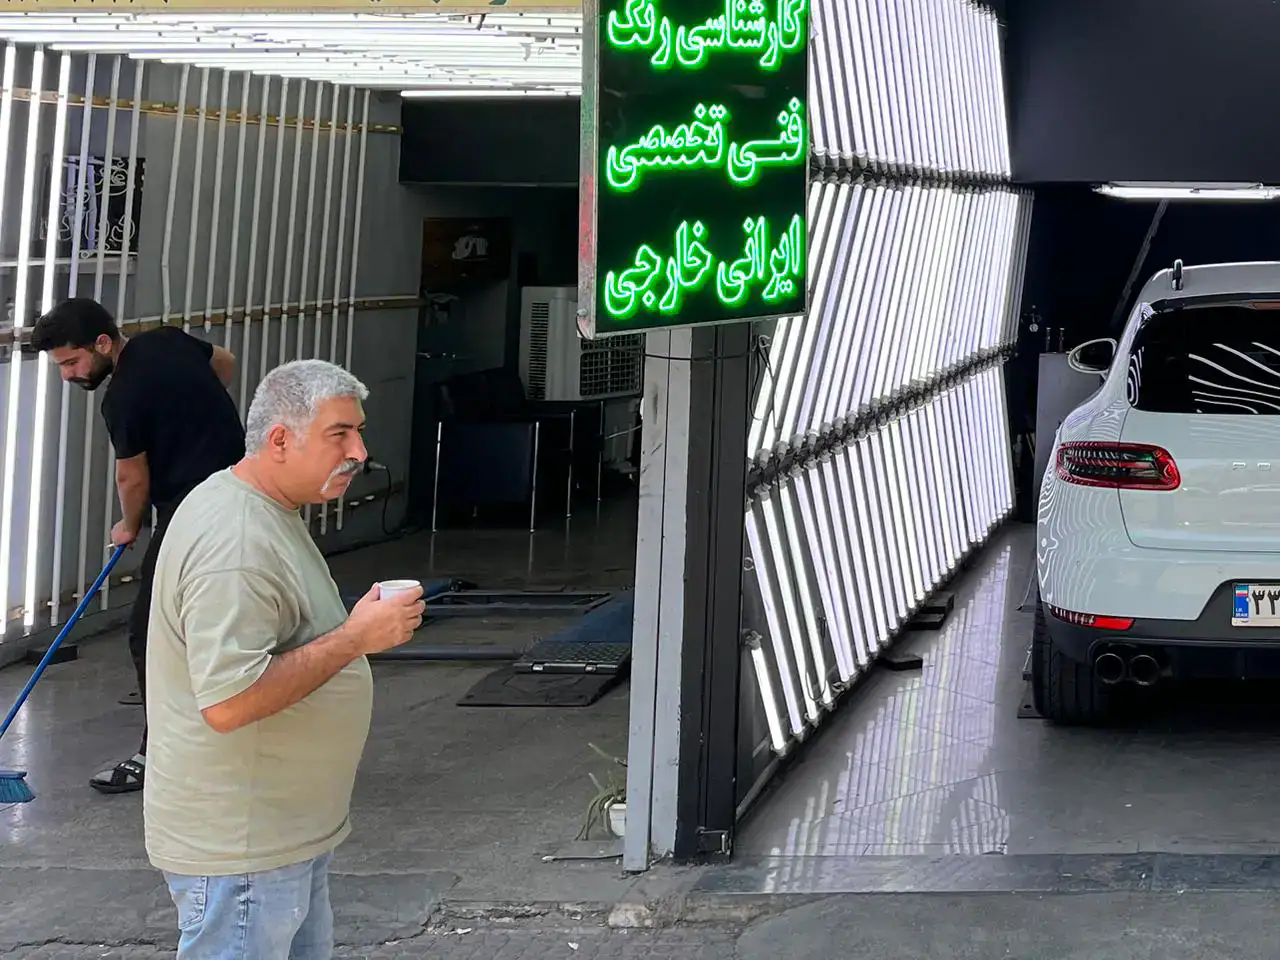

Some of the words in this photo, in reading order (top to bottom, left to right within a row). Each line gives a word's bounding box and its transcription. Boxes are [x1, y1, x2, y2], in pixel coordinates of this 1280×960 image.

[606, 103, 726, 188] تخصصی
[727, 97, 804, 182] فنی
[605, 220, 712, 315] خارجی
[717, 214, 801, 303] ایرانی
[1252, 589, 1280, 615] ۳۳
